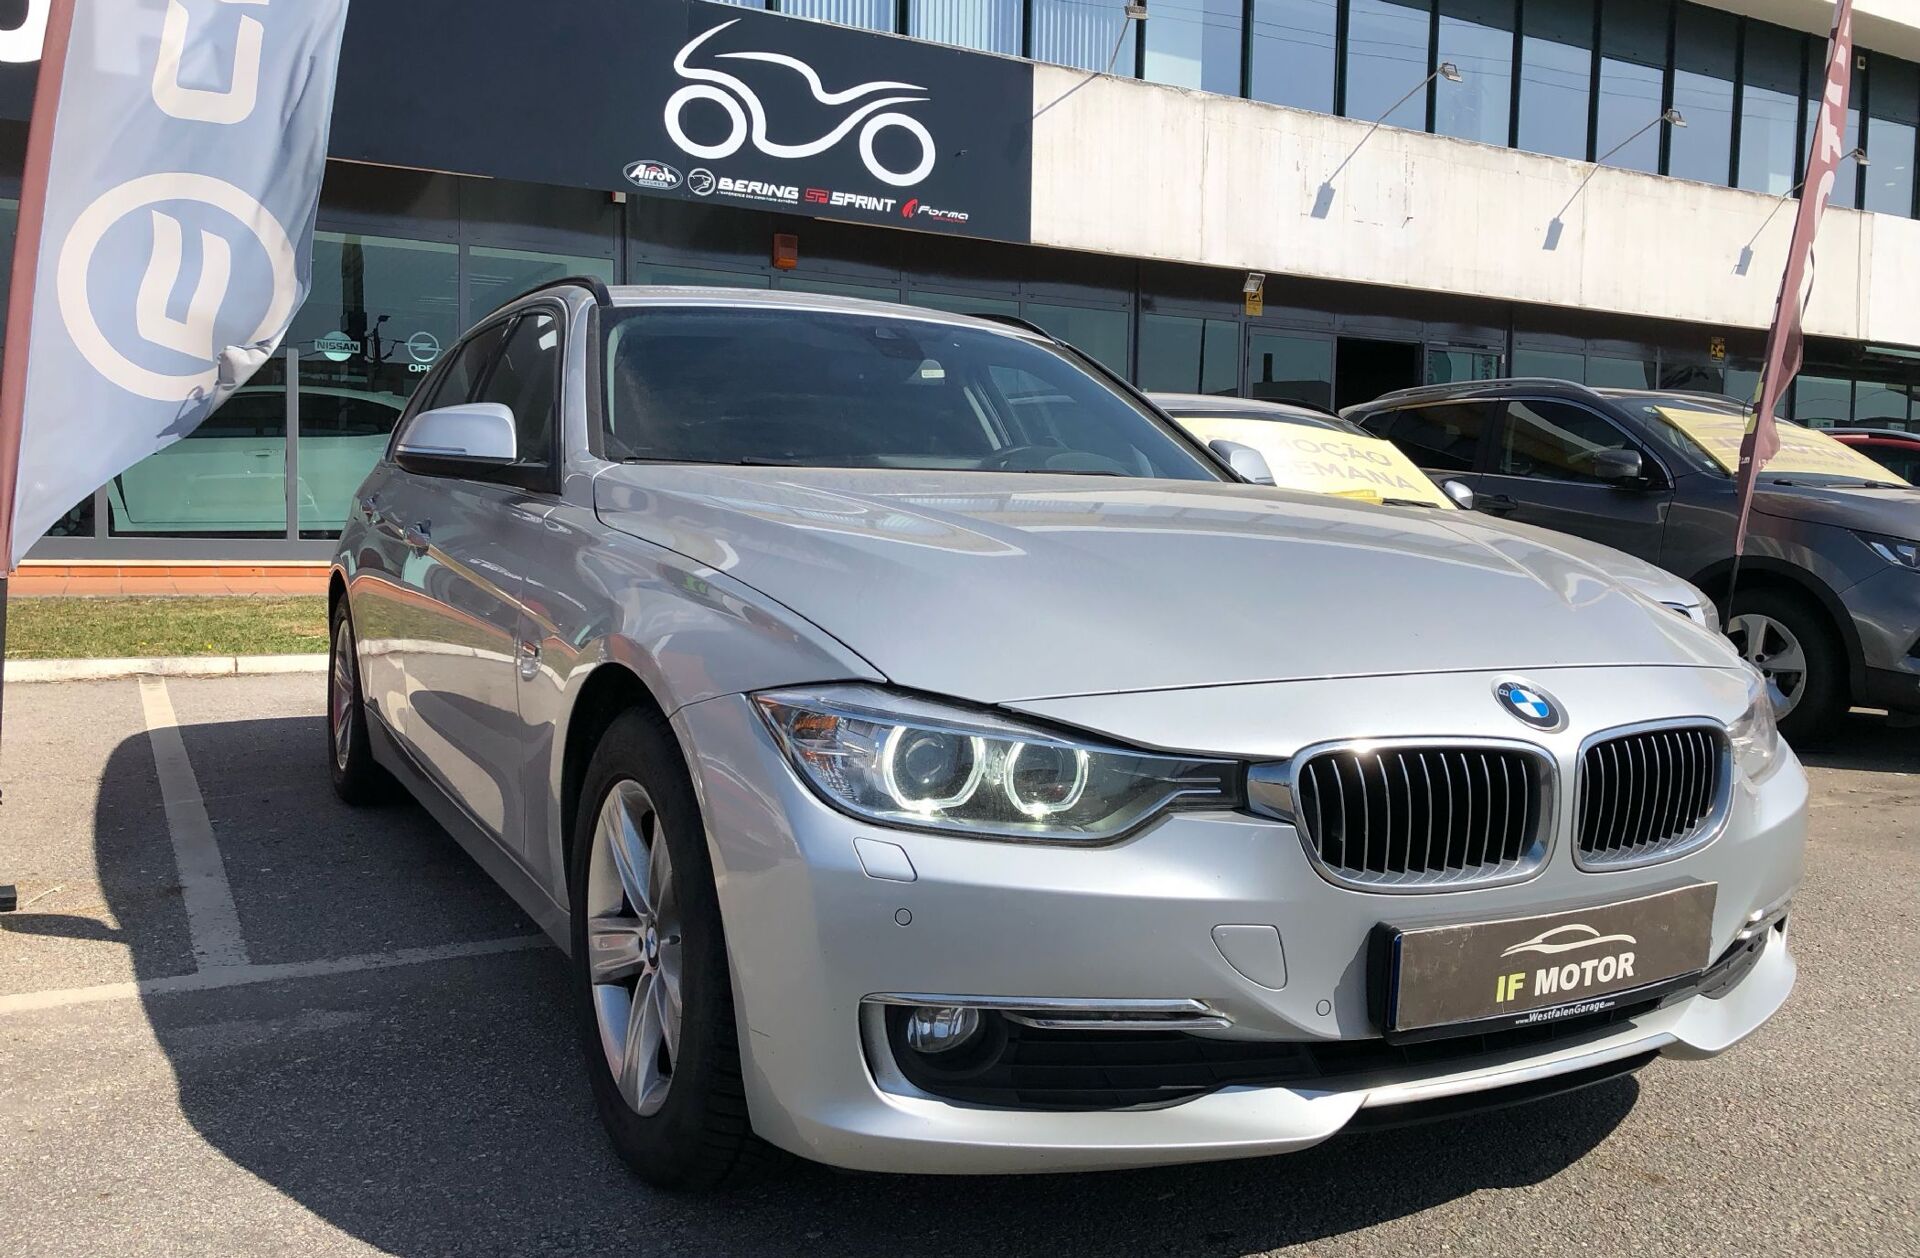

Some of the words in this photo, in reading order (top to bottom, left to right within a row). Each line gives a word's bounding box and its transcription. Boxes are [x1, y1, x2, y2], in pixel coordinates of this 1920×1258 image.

[630, 164, 677, 183] Airoh
[718, 177, 799, 199] BERING
[829, 191, 897, 213] SPRINT
[917, 205, 969, 220] Forma
[316, 340, 359, 352] NISSAN
[408, 363, 432, 373] OPE
[1496, 973, 1526, 1003] IF
[1534, 951, 1636, 996] MOTOR
[1515, 1000, 1616, 1025] www.WestfalenGarage.com
